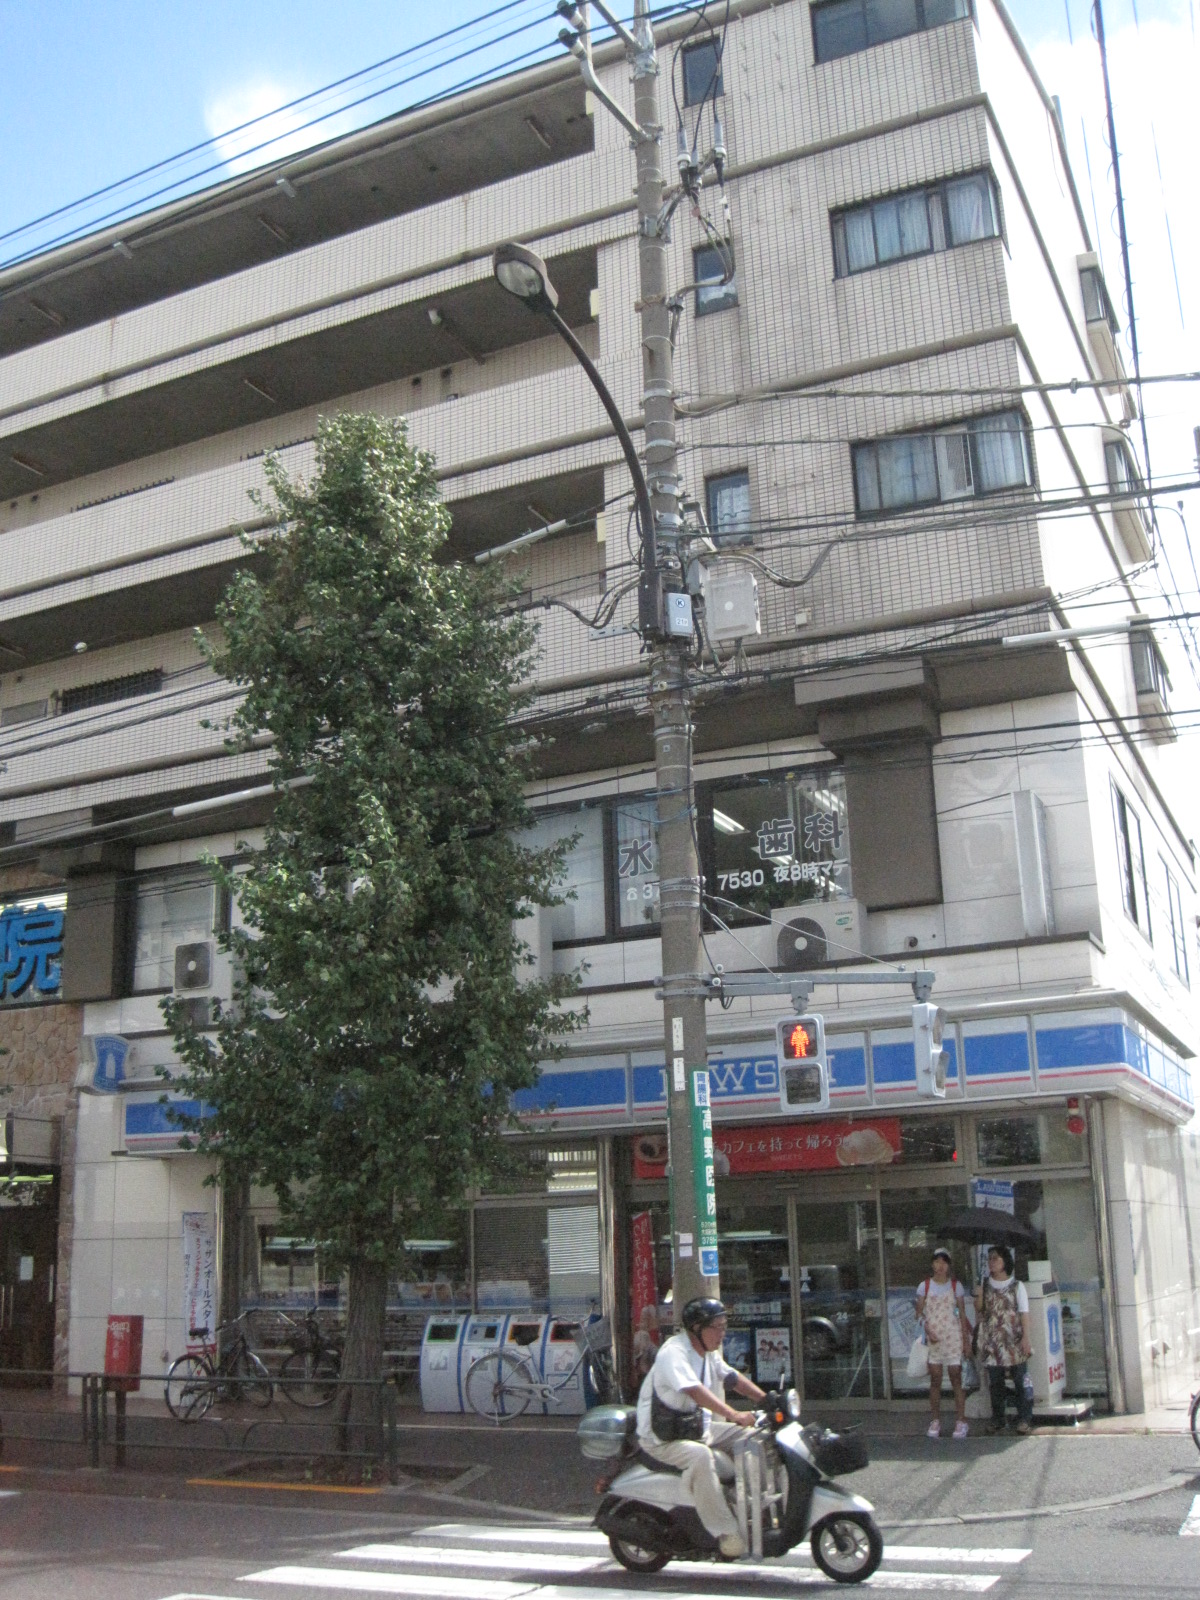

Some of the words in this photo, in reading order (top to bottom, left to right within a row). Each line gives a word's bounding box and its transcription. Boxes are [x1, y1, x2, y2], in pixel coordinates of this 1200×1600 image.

[757, 811, 844, 859] 歯科
[717, 870, 764, 891] 7530
[0, 902, 65, 992] 院
